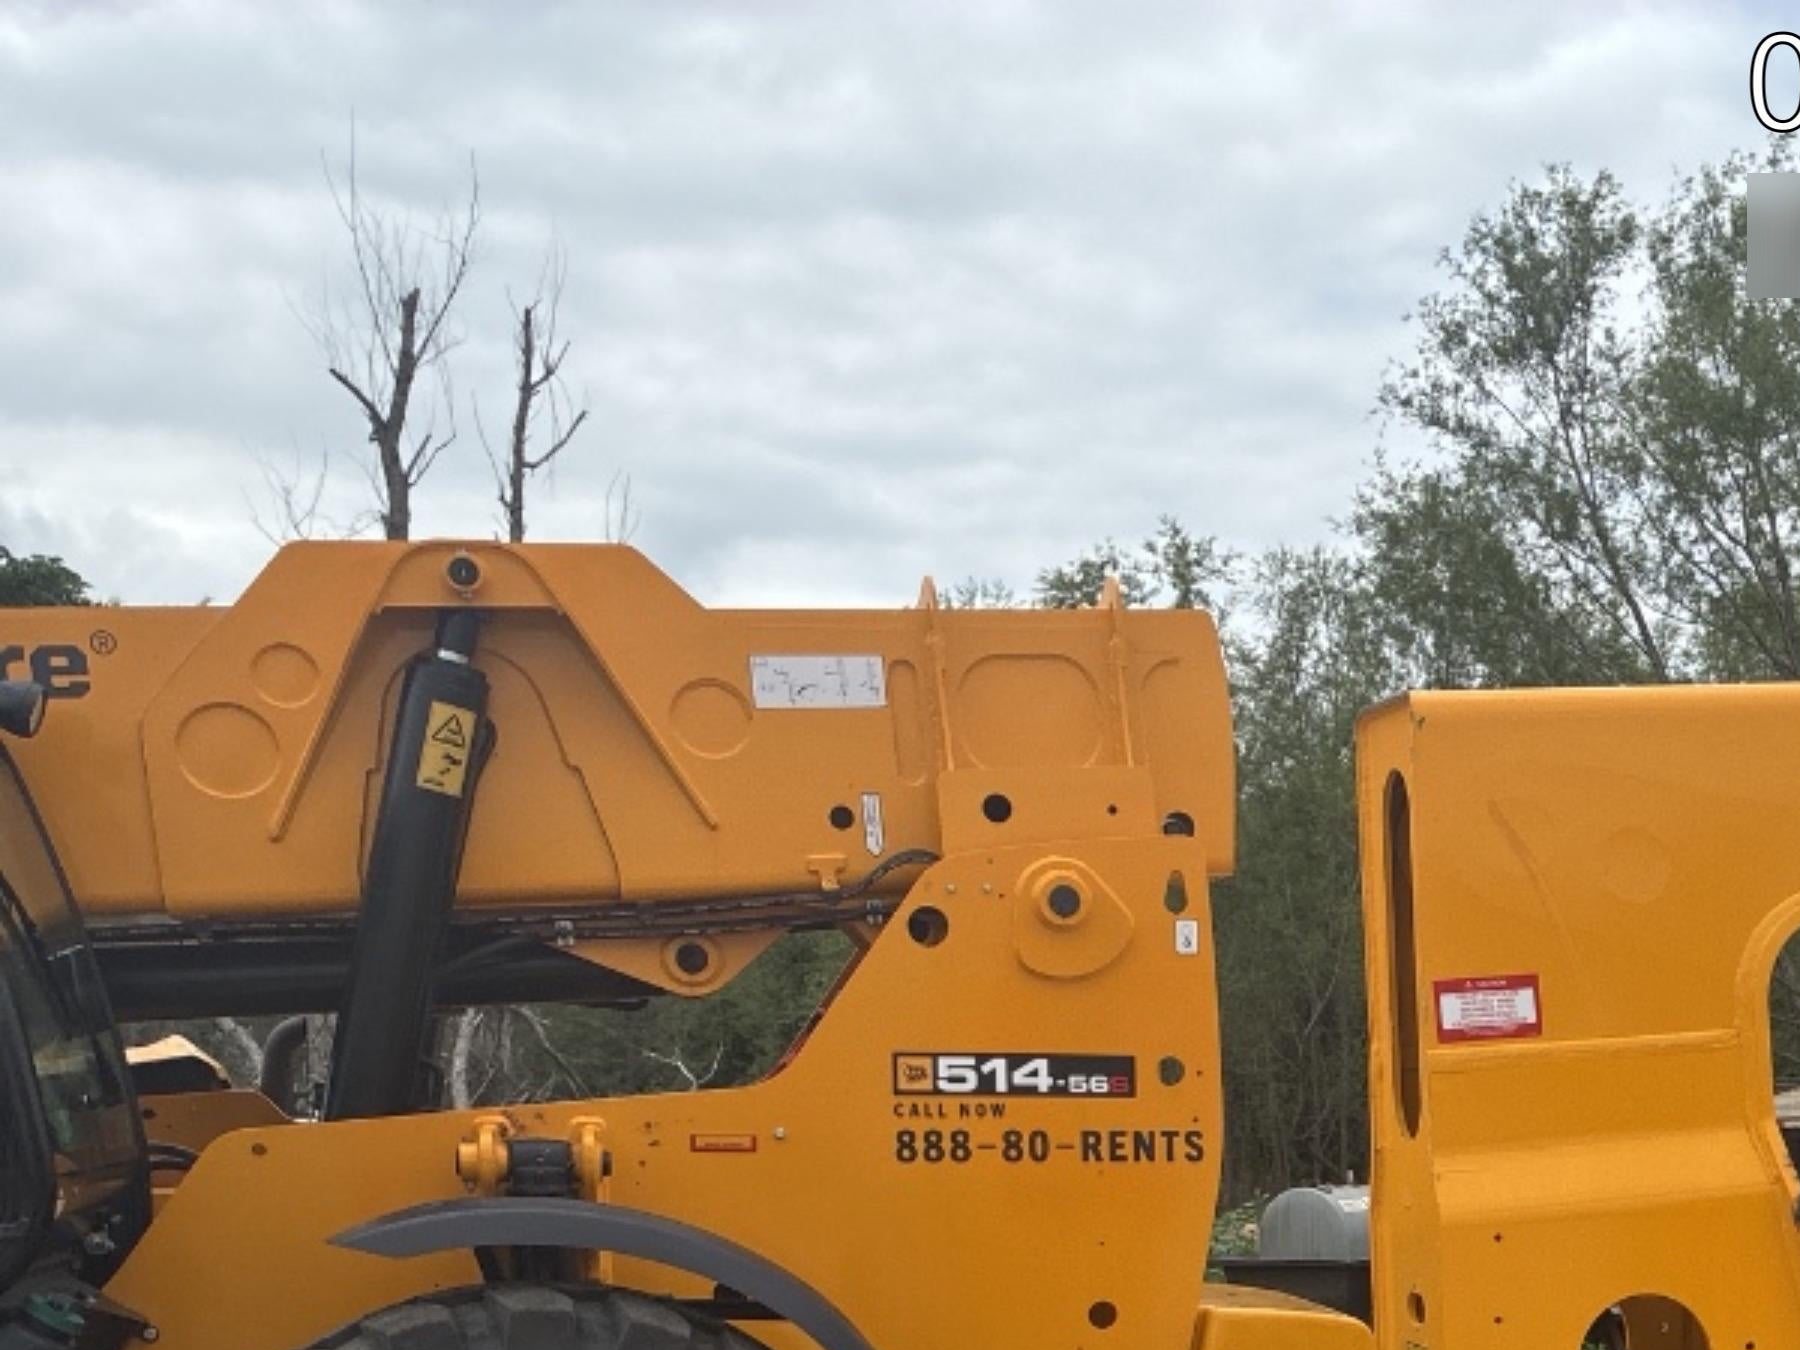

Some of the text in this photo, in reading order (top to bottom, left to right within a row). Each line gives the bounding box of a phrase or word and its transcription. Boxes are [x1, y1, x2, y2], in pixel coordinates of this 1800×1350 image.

[893, 1103, 1006, 1117] CALL NOW
[896, 1129, 1205, 1163] 888-80-RENTS
